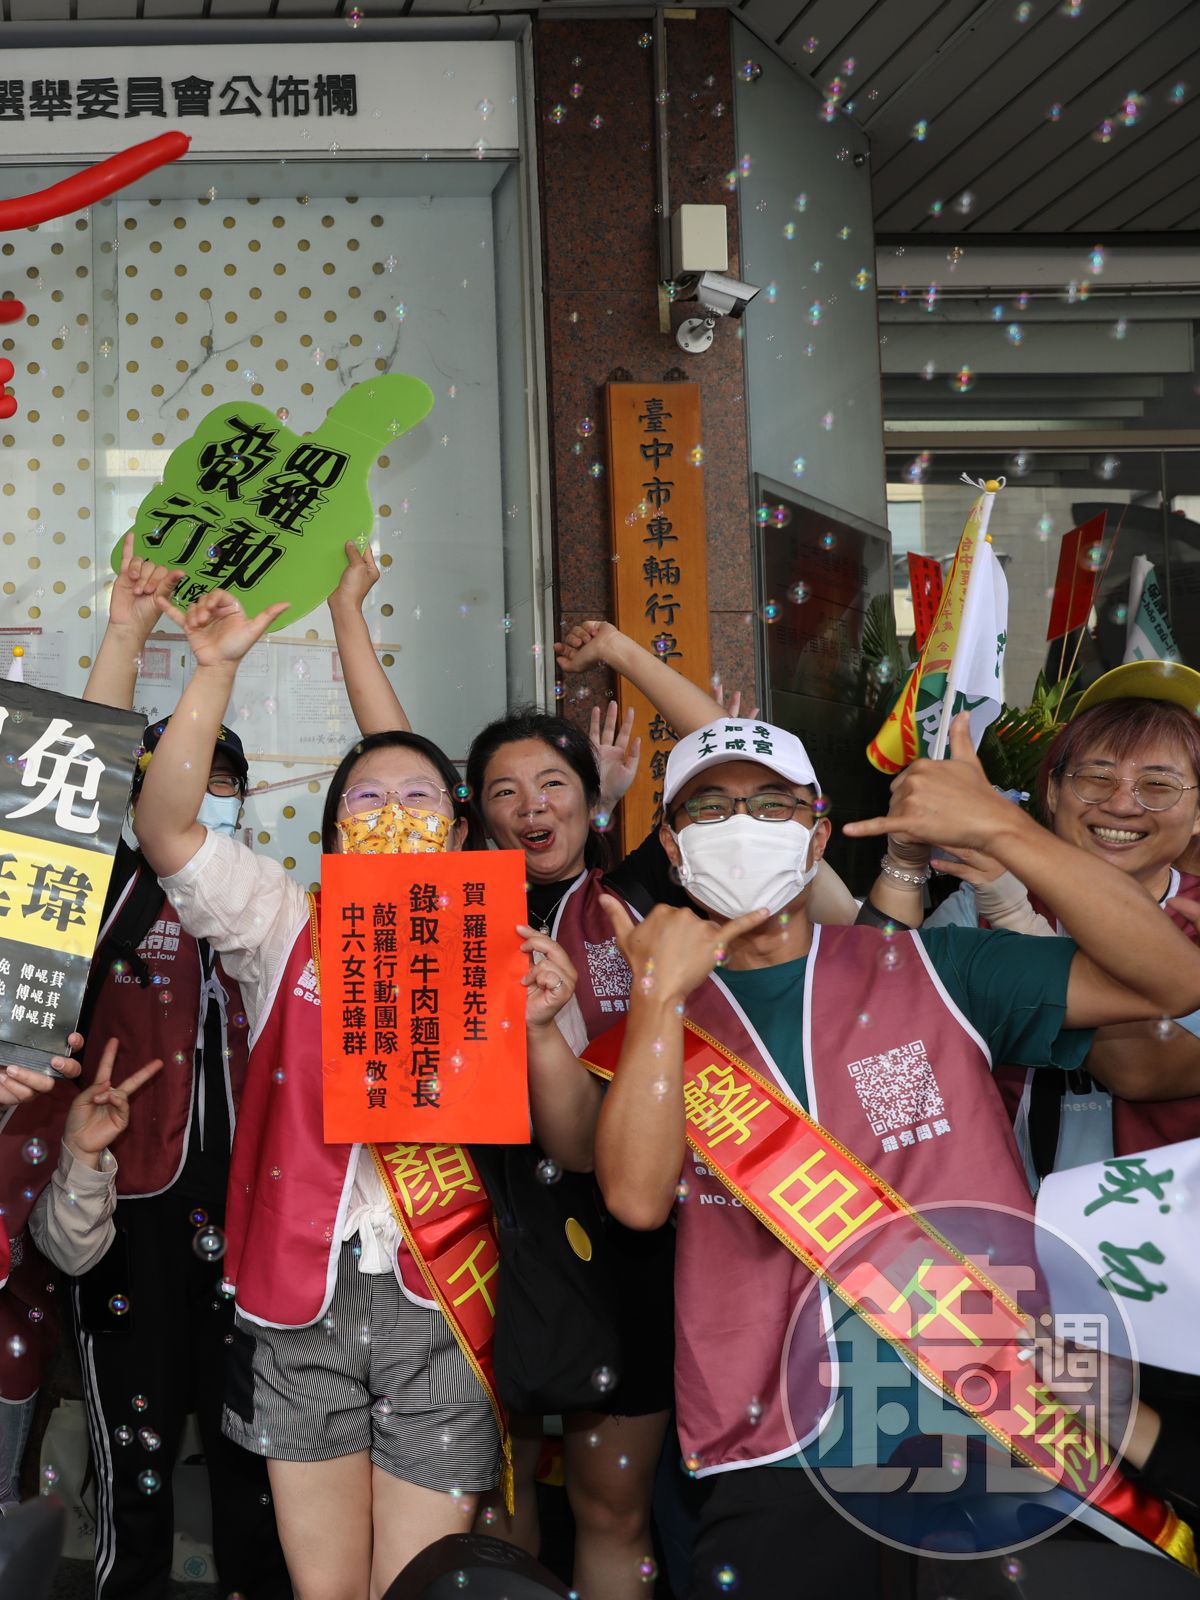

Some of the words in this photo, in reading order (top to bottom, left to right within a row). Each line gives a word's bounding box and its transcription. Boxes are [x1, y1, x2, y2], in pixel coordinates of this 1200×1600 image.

[698, 739, 774, 759] 大成宮
[409, 883, 440, 946] 錄取
[462, 882, 486, 906] 賀
[341, 902, 367, 1055] 中六女王蜂群
[372, 902, 398, 1055] 敲羅行動團隊
[462, 914, 488, 1041] 羅廷瑋先生
[409, 953, 441, 1109] 牛肉麵店長
[366, 1060, 388, 1109] 敬賀
